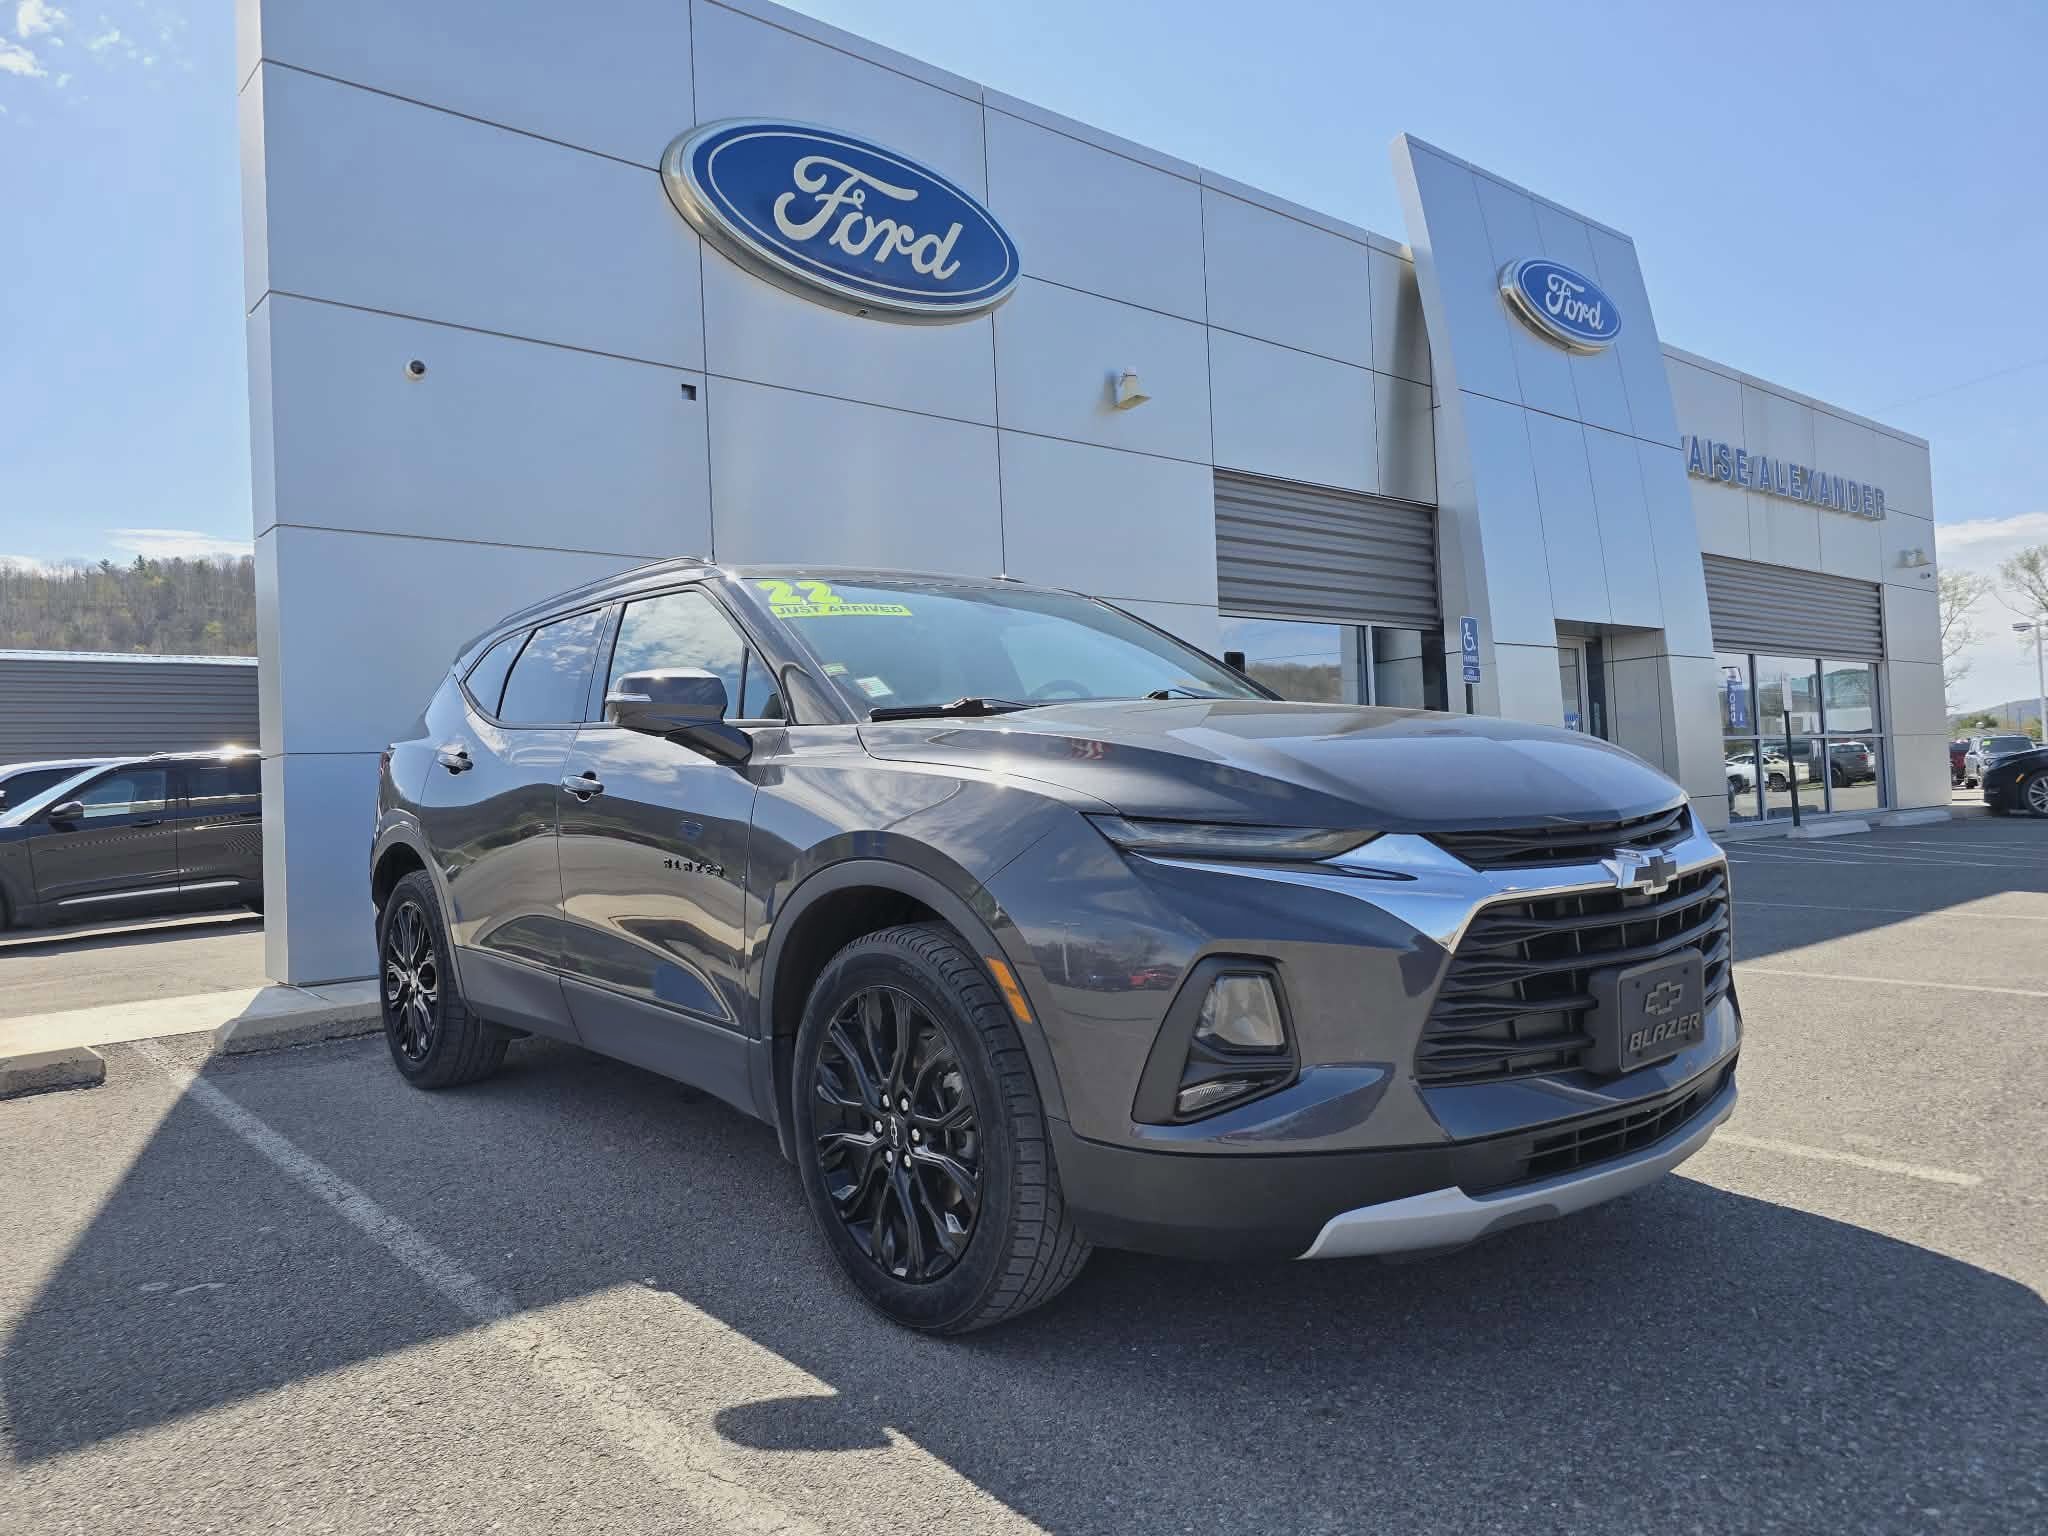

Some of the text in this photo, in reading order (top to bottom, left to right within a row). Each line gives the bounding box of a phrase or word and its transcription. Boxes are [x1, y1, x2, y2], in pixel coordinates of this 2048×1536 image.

[774, 156, 962, 280] Ford
[1546, 273, 1604, 330] Ford
[1681, 434, 1887, 520] AISE ALEXANDER
[777, 605, 904, 616] JUST ARRIVED
[1629, 1012, 1700, 1053] BLAZER
